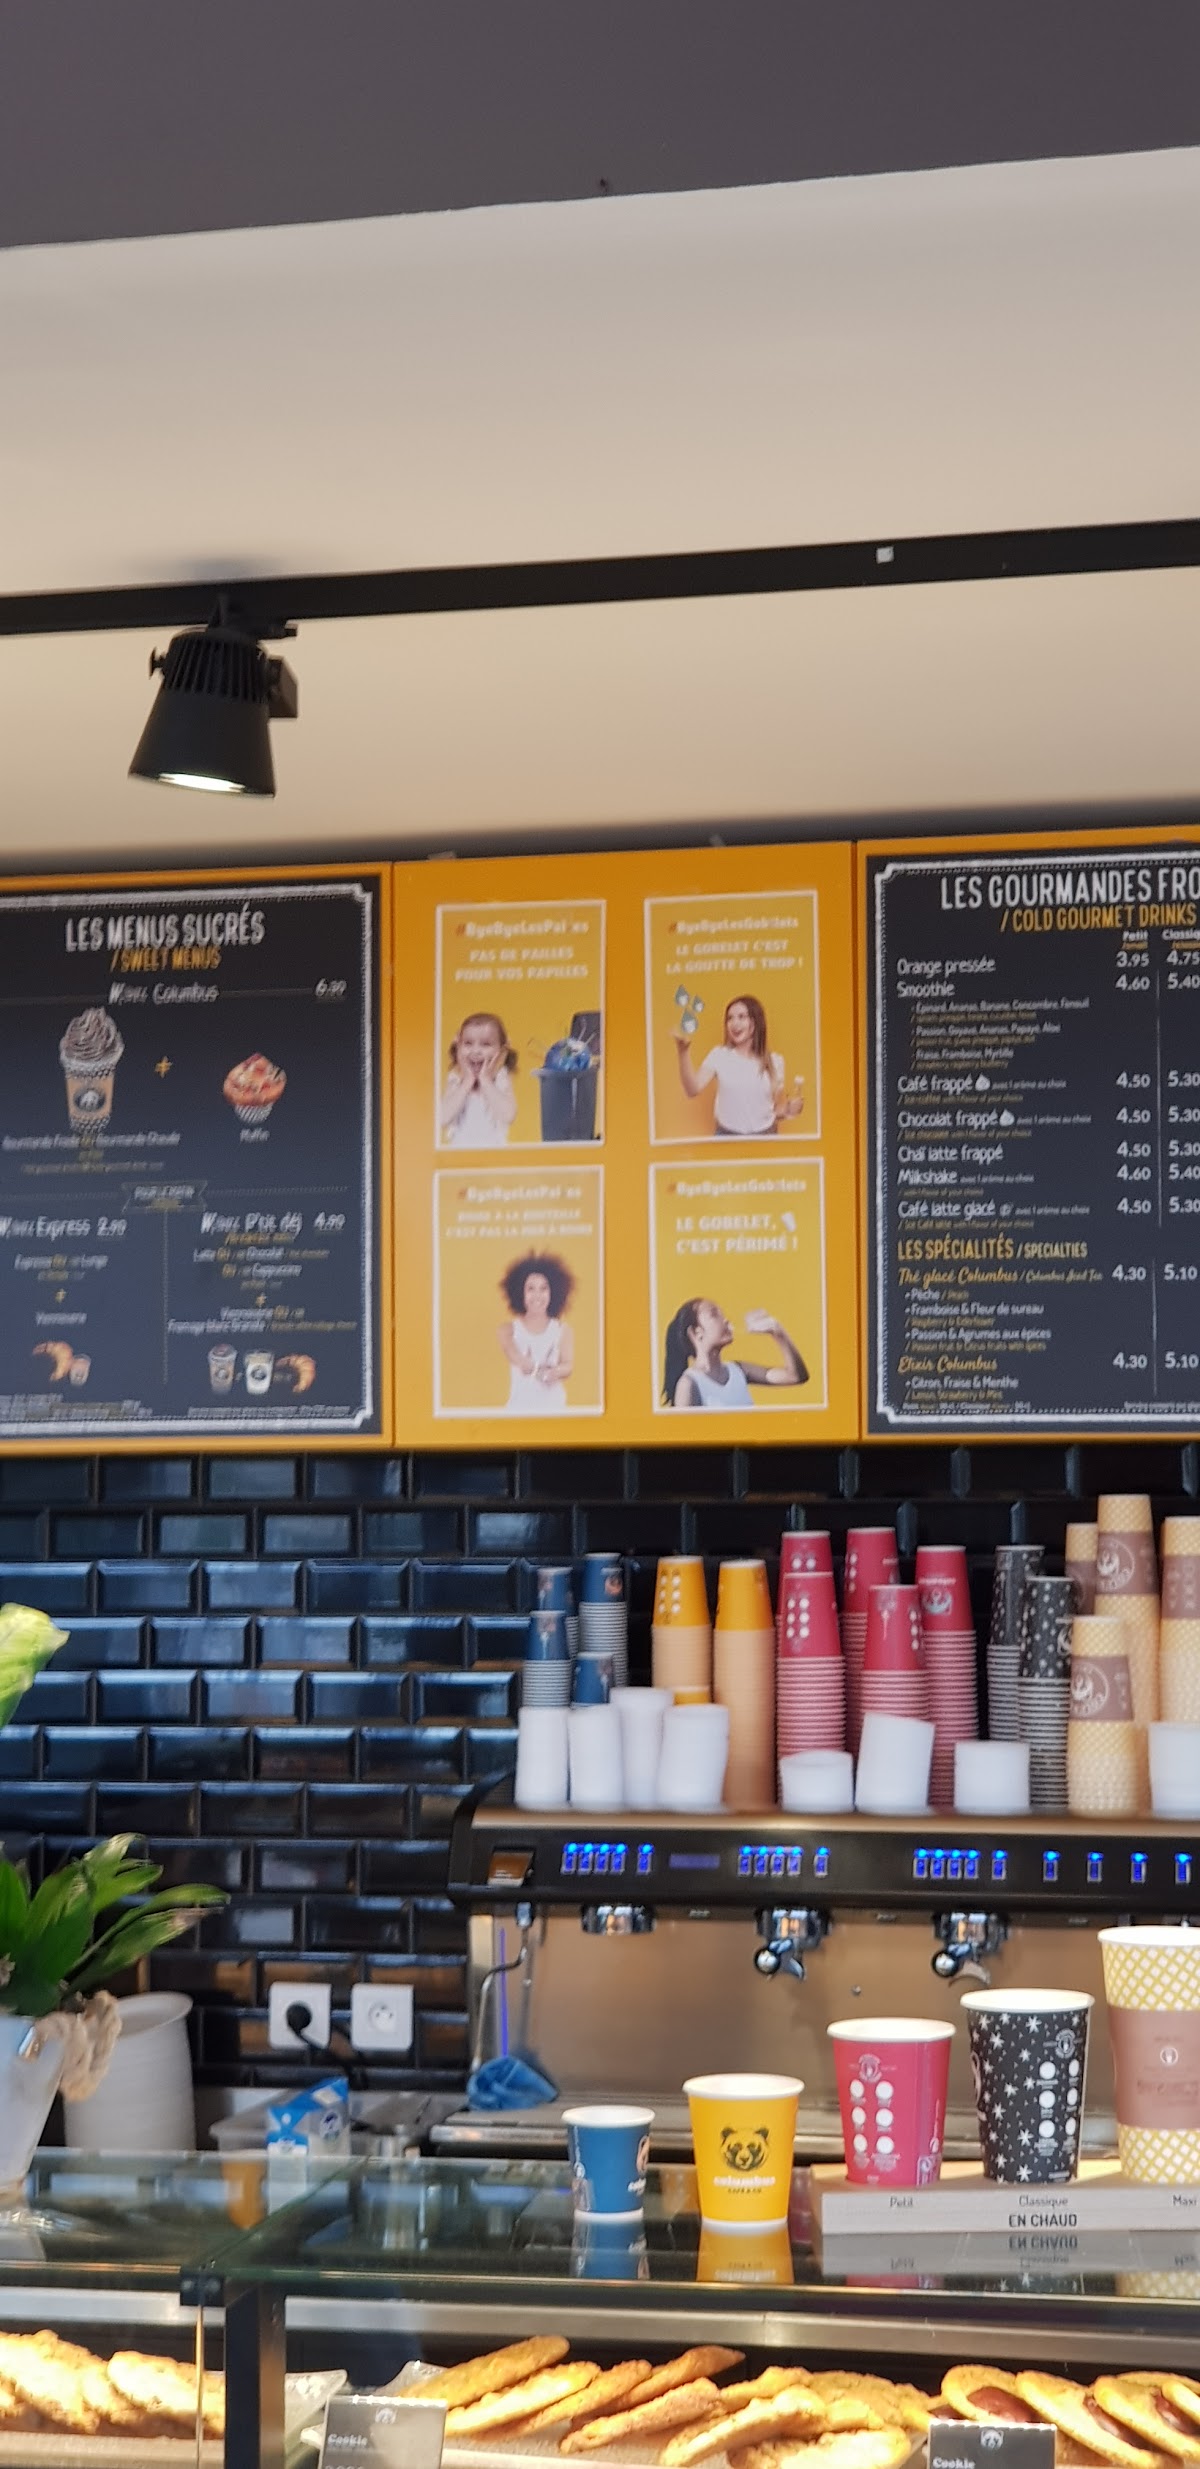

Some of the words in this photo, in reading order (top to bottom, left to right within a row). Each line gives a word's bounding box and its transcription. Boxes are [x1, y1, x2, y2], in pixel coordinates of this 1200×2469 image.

[941, 874, 984, 911] LES
[987, 868, 1152, 909] GOURMANDES
[65, 917, 103, 952] LES
[107, 912, 178, 950] MENUS
[182, 902, 267, 947] SUCRÉS
[1000, 908, 1010, 933] /
[1012, 907, 1054, 932] COLD
[1056, 904, 1134, 931] GOURMET
[1138, 902, 1197, 927] DRINKS
[1122, 929, 1149, 942] Petit
[521, 946, 574, 960] PAILLES
[693, 940, 749, 955] GOBELET
[526, 964, 589, 980] PAPILLES
[685, 959, 735, 974] GOUTTE
[896, 957, 943, 980] Orange
[944, 954, 997, 979] pressée
[1115, 950, 1150, 968] 3.95
[1166, 949, 1200, 966] 4.75
[896, 980, 956, 999] Smoothie
[1115, 973, 1151, 991] 4.60
[1167, 972, 1200, 990] 5.40
[897, 1073, 928, 1093] Café
[931, 1071, 974, 1095] frappé
[1115, 1070, 1151, 1088] 4.50
[1167, 1069, 1200, 1088] 5.30
[897, 1110, 953, 1128] Chocolat
[955, 1108, 999, 1131] frappé
[1115, 1106, 1151, 1124] 4.50
[1168, 1106, 1200, 1123] 5.30
[928, 1145, 958, 1162] latte
[960, 1142, 1004, 1165] frappé
[1116, 1140, 1151, 1158] 4.50
[1168, 1139, 1200, 1157] 5.30
[897, 1168, 958, 1185] Milkshake
[1116, 1164, 1151, 1181] 4.60
[1168, 1163, 1200, 1180] 5.40
[897, 1199, 928, 1218] Café
[931, 1200, 961, 1217] latte
[963, 1198, 996, 1221] glacé
[1116, 1197, 1152, 1214] 4.50
[1168, 1196, 1200, 1213] 5.30
[675, 1217, 694, 1233] LE
[698, 1213, 777, 1232] GOBELET,
[675, 1237, 721, 1255] C'EST
[725, 1231, 788, 1253] PÉRIMÉ
[897, 1239, 923, 1261] LES
[925, 1232, 1014, 1261] SPÉCIALITÉS
[1024, 1241, 1088, 1259] SPECIALTIES
[898, 1266, 921, 1287] Thé
[923, 1267, 956, 1290] glacé
[957, 1265, 1019, 1285] Columbus
[1111, 1263, 1147, 1281] 4.30
[1163, 1263, 1198, 1281] 5.10
[910, 1302, 961, 1316] Framboise
[970, 1301, 996, 1315] Fleur
[997, 1301, 1010, 1315] de
[1010, 1303, 1045, 1315] sureau
[910, 1328, 948, 1341] Passion
[957, 1327, 1000, 1344] Agrumes
[1002, 1329, 1019, 1340] aux
[1020, 1326, 1052, 1342] épices
[936, 1354, 998, 1374] Columbus
[1112, 1352, 1148, 1369] 4.30
[1164, 1351, 1199, 1369] 5.10
[943, 1375, 971, 1388] Fraise
[982, 1374, 1019, 1388] Menthe
[889, 2196, 914, 2209] Petit
[1018, 2195, 1069, 2209] Classique
[1172, 2195, 1198, 2208] Maxi
[1009, 2213, 1027, 2228] EN
[1030, 2212, 1078, 2228] CHAUD
[327, 2433, 368, 2447] Cookie
